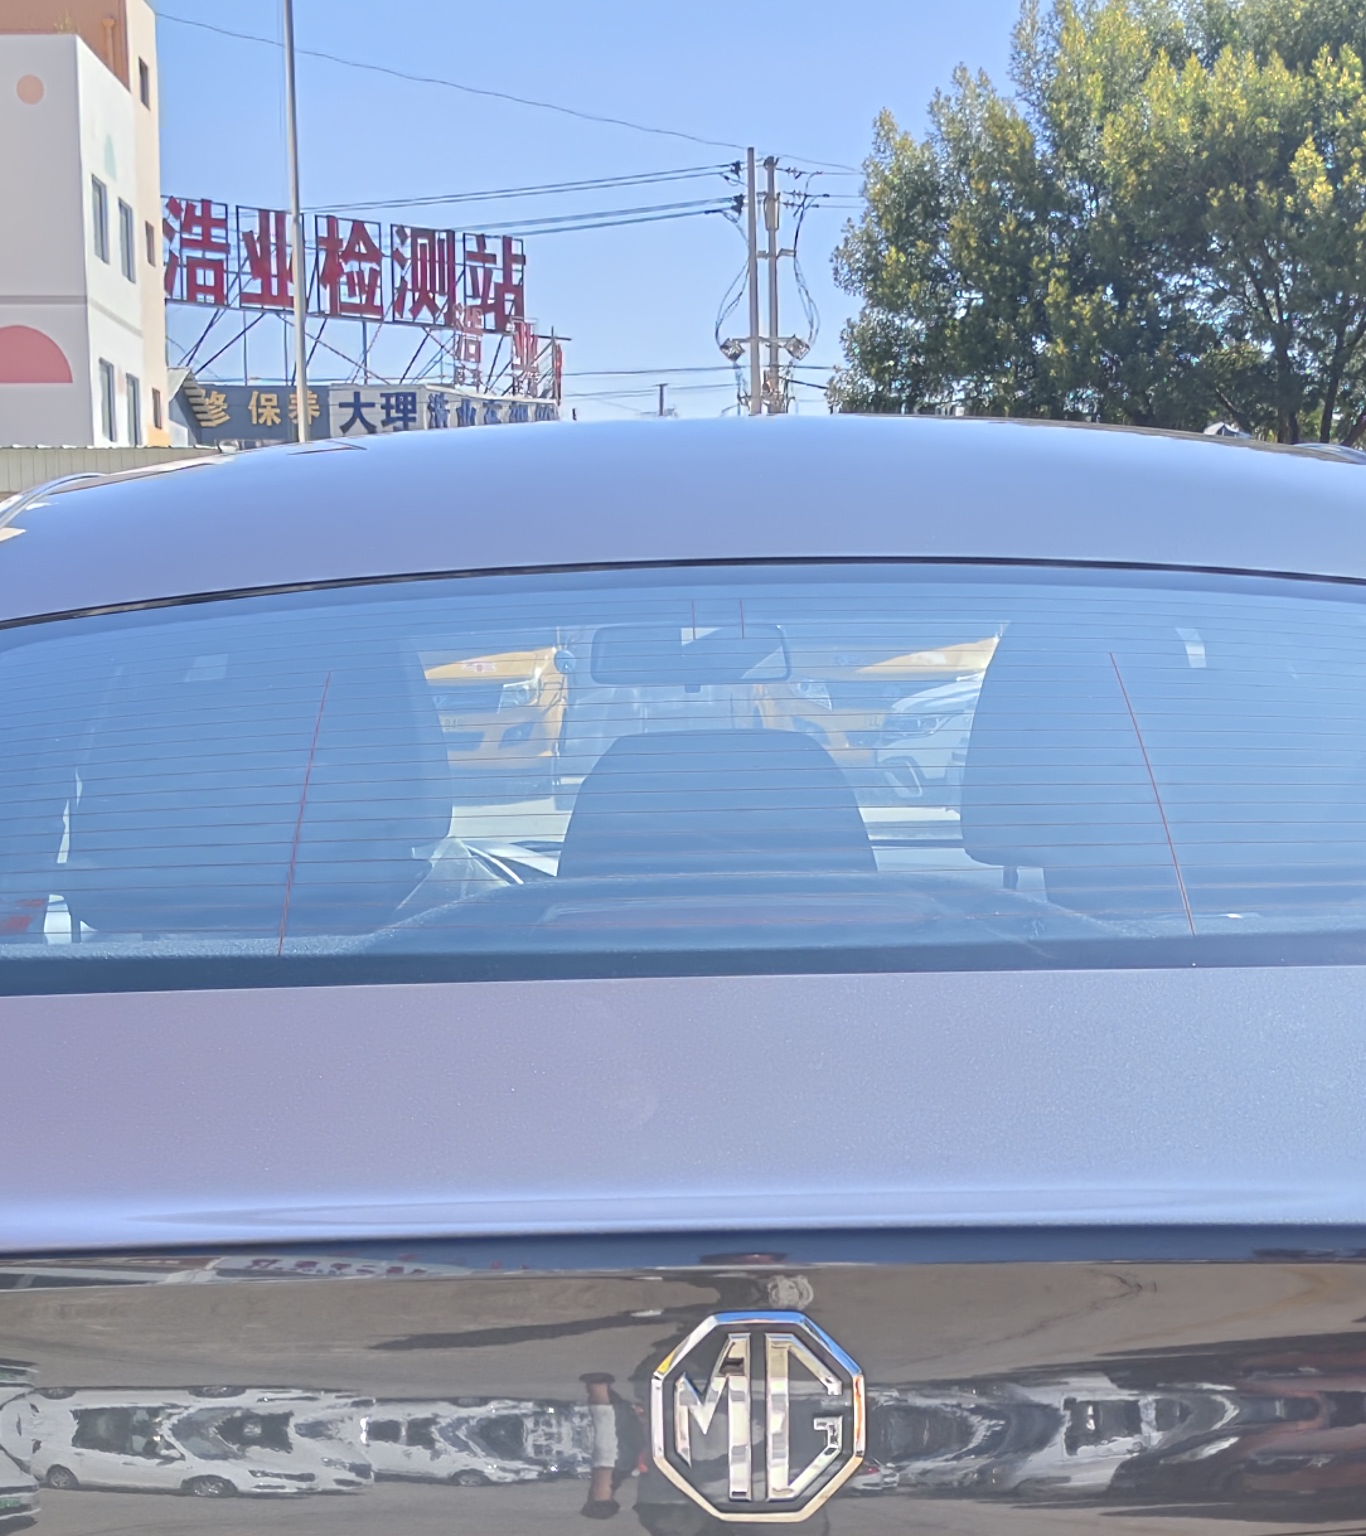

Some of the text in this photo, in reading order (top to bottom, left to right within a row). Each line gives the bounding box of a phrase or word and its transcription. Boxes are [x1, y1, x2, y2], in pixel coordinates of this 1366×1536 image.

[162, 194, 527, 331] 浩业检测站
[674, 1331, 844, 1503] MG
